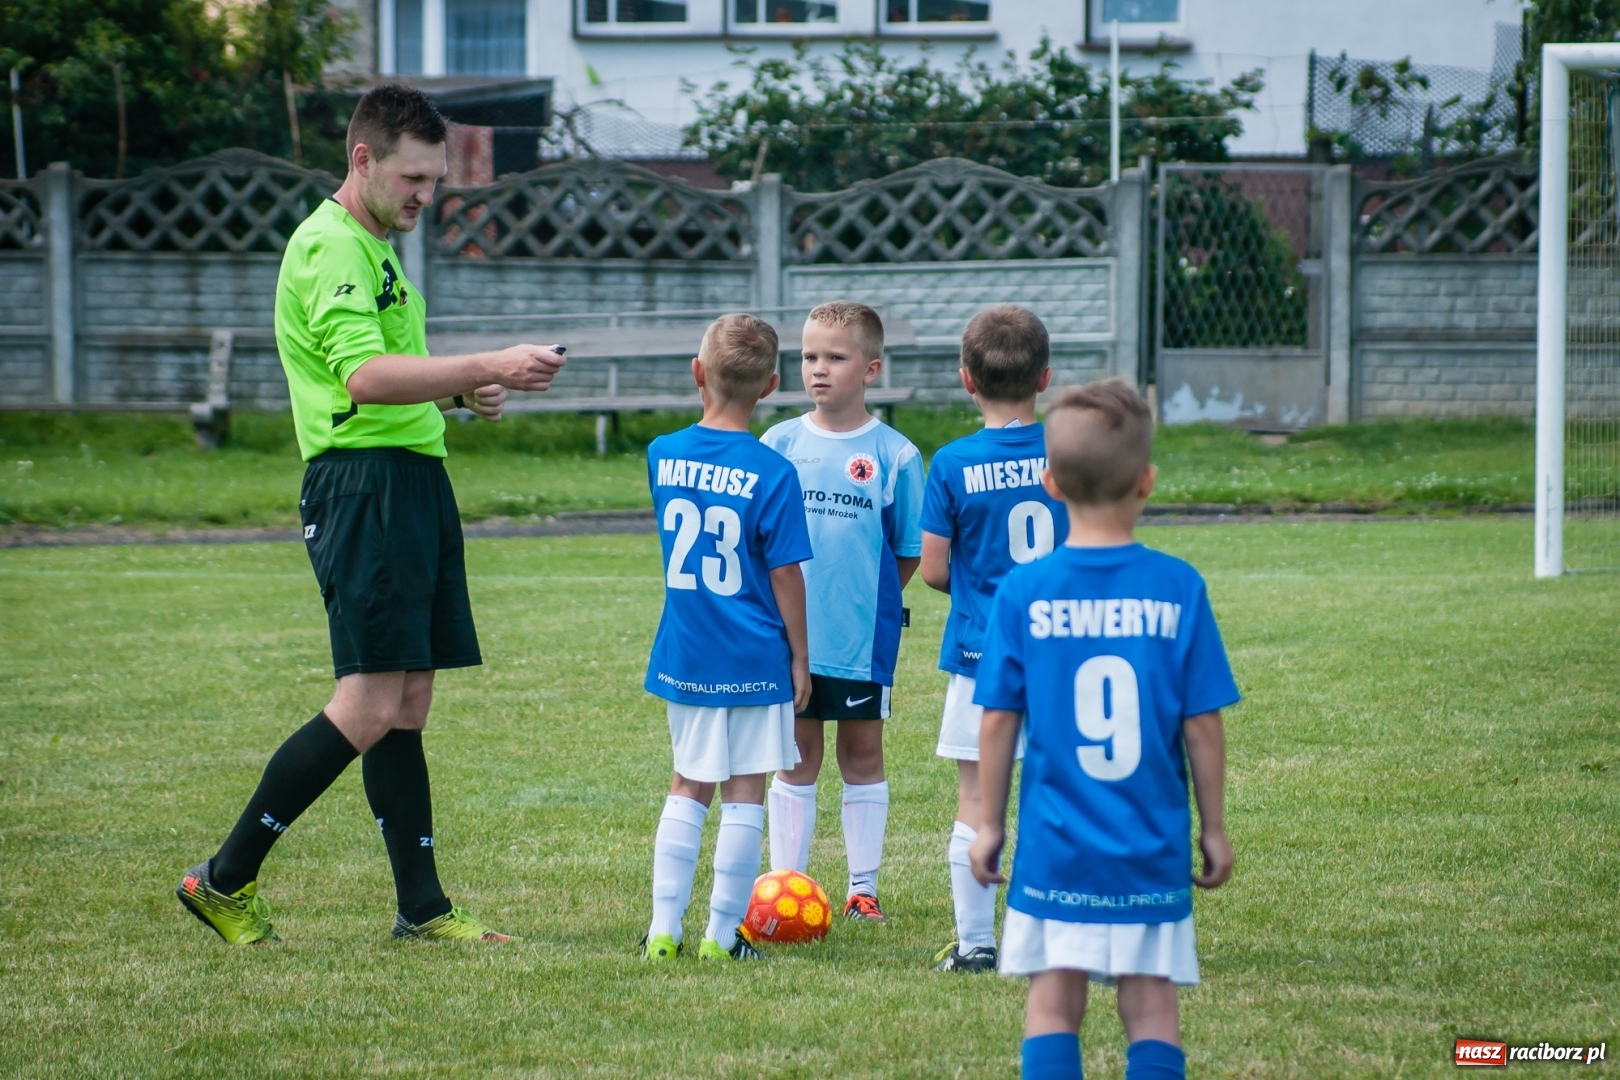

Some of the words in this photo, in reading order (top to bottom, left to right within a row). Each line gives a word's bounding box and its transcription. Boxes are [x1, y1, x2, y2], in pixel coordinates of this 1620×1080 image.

[657, 458, 760, 500] MATEUSZ
[803, 490, 874, 511] UTO-TOMA
[828, 508, 859, 520] Mrożek
[663, 497, 743, 597] 23
[1029, 598, 1182, 640] SEWERYN
[1073, 655, 1142, 782] 9
